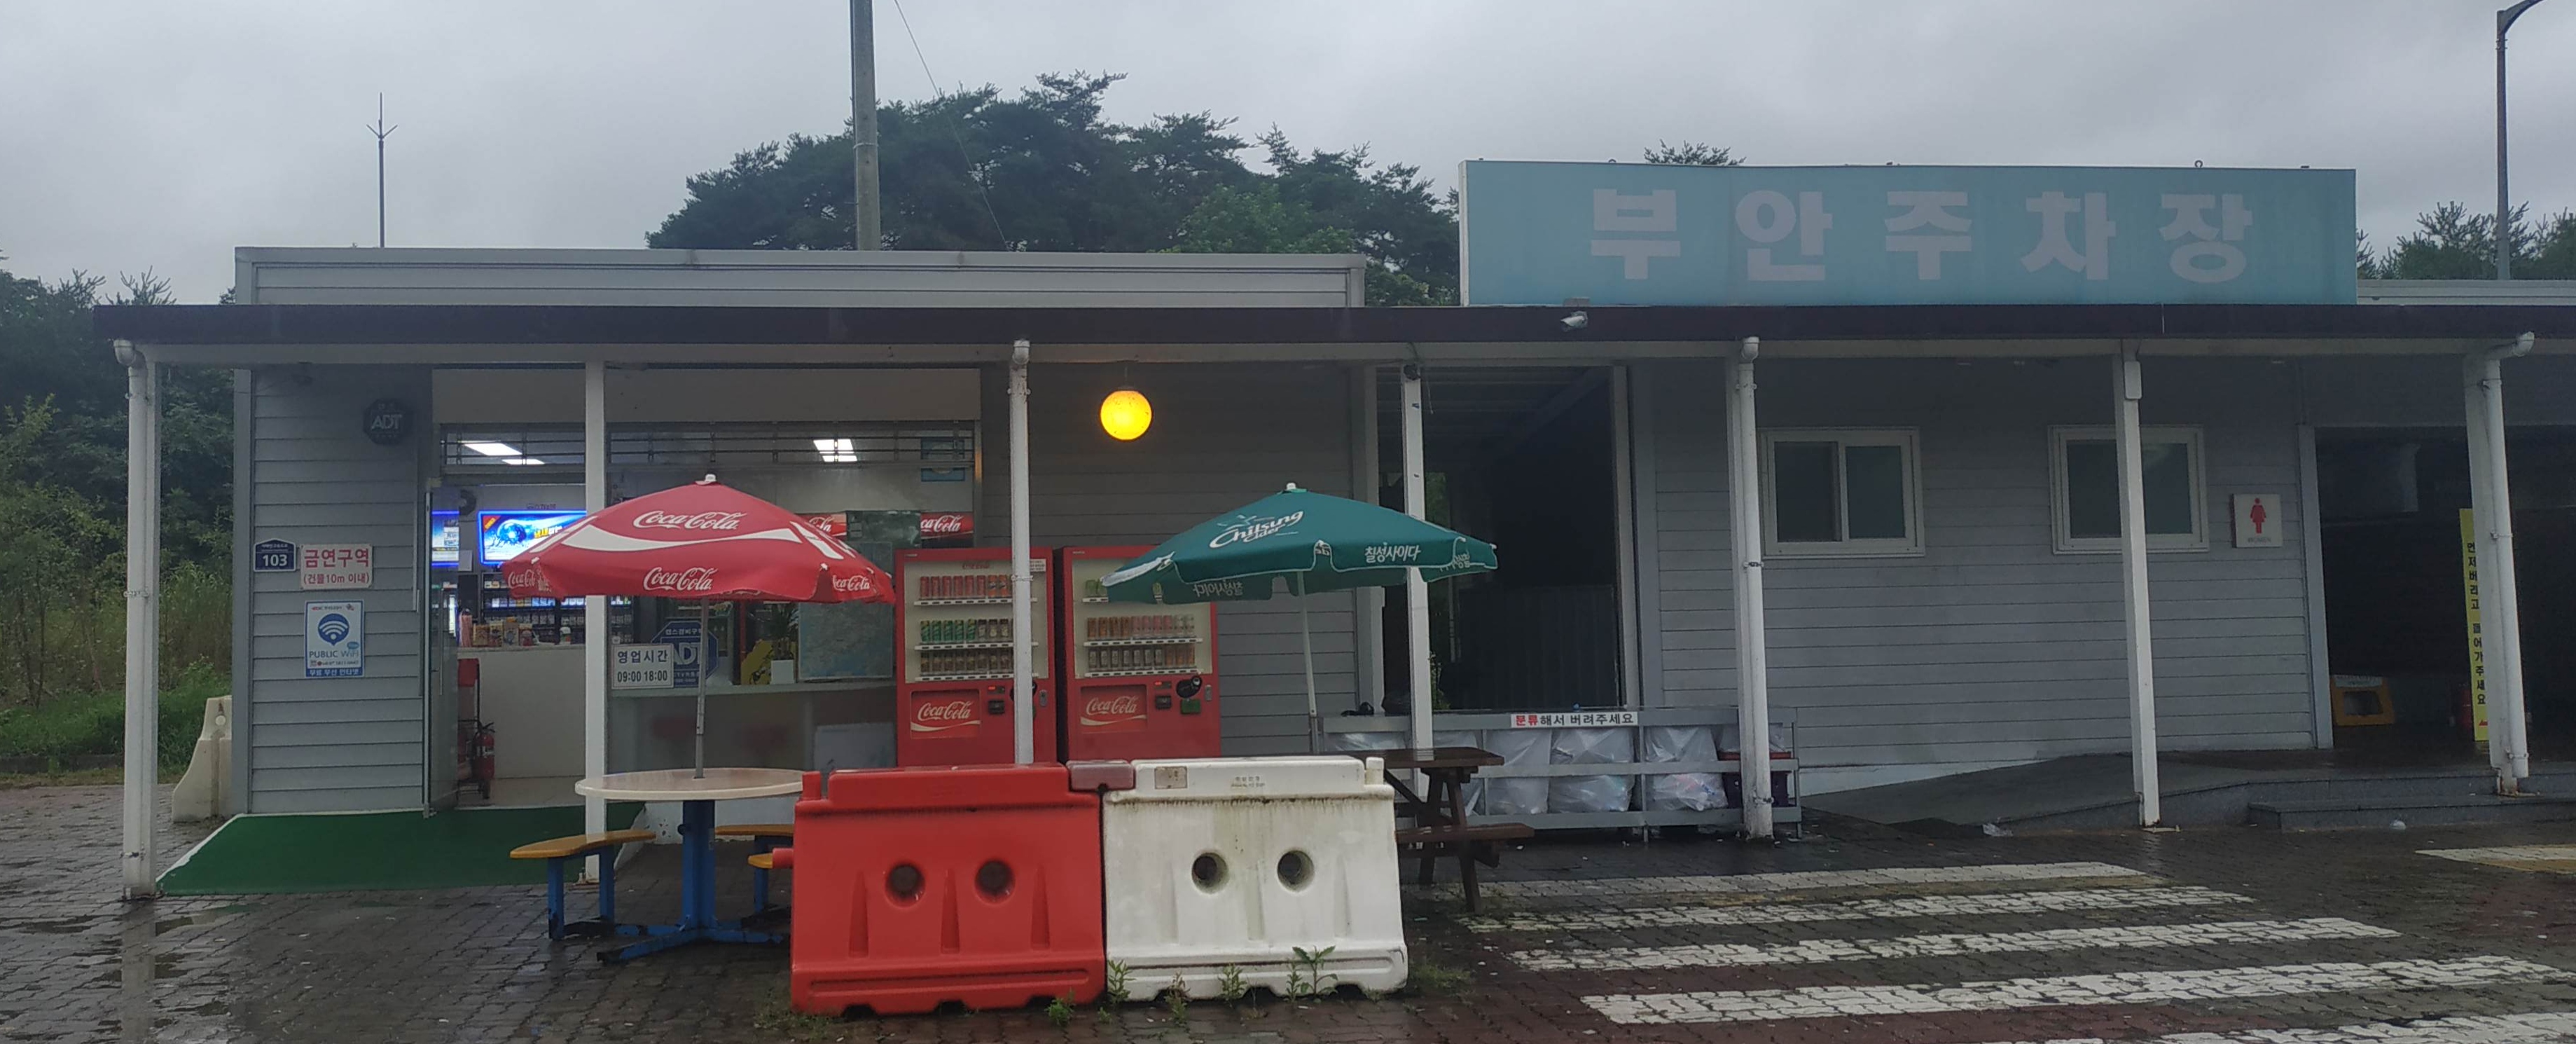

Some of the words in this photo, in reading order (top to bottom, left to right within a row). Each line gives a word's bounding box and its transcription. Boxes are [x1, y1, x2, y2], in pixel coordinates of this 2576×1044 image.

[1591, 188, 2253, 283] 부안주차장
[371, 414, 403, 429] ADT
[633, 510, 747, 530] Coca-Cola
[920, 515, 964, 533] ca-Cola
[1210, 511, 1304, 549] Chilsung
[262, 554, 288, 567] 103
[304, 548, 370, 568] 금연구역
[1364, 542, 1421, 563] 칠성사이다
[643, 566, 718, 591] Coca-Cola
[309, 650, 338, 659] PUBLIC
[617, 650, 668, 664] 영업시간
[617, 671, 642, 682] 09:00
[644, 670, 668, 682] 18:00
[917, 701, 974, 722] Coca-Cola
[1086, 696, 1139, 716] Coca-Cola
[1516, 714, 1565, 726] 분류해서
[1570, 713, 1634, 726] 버려주세요
